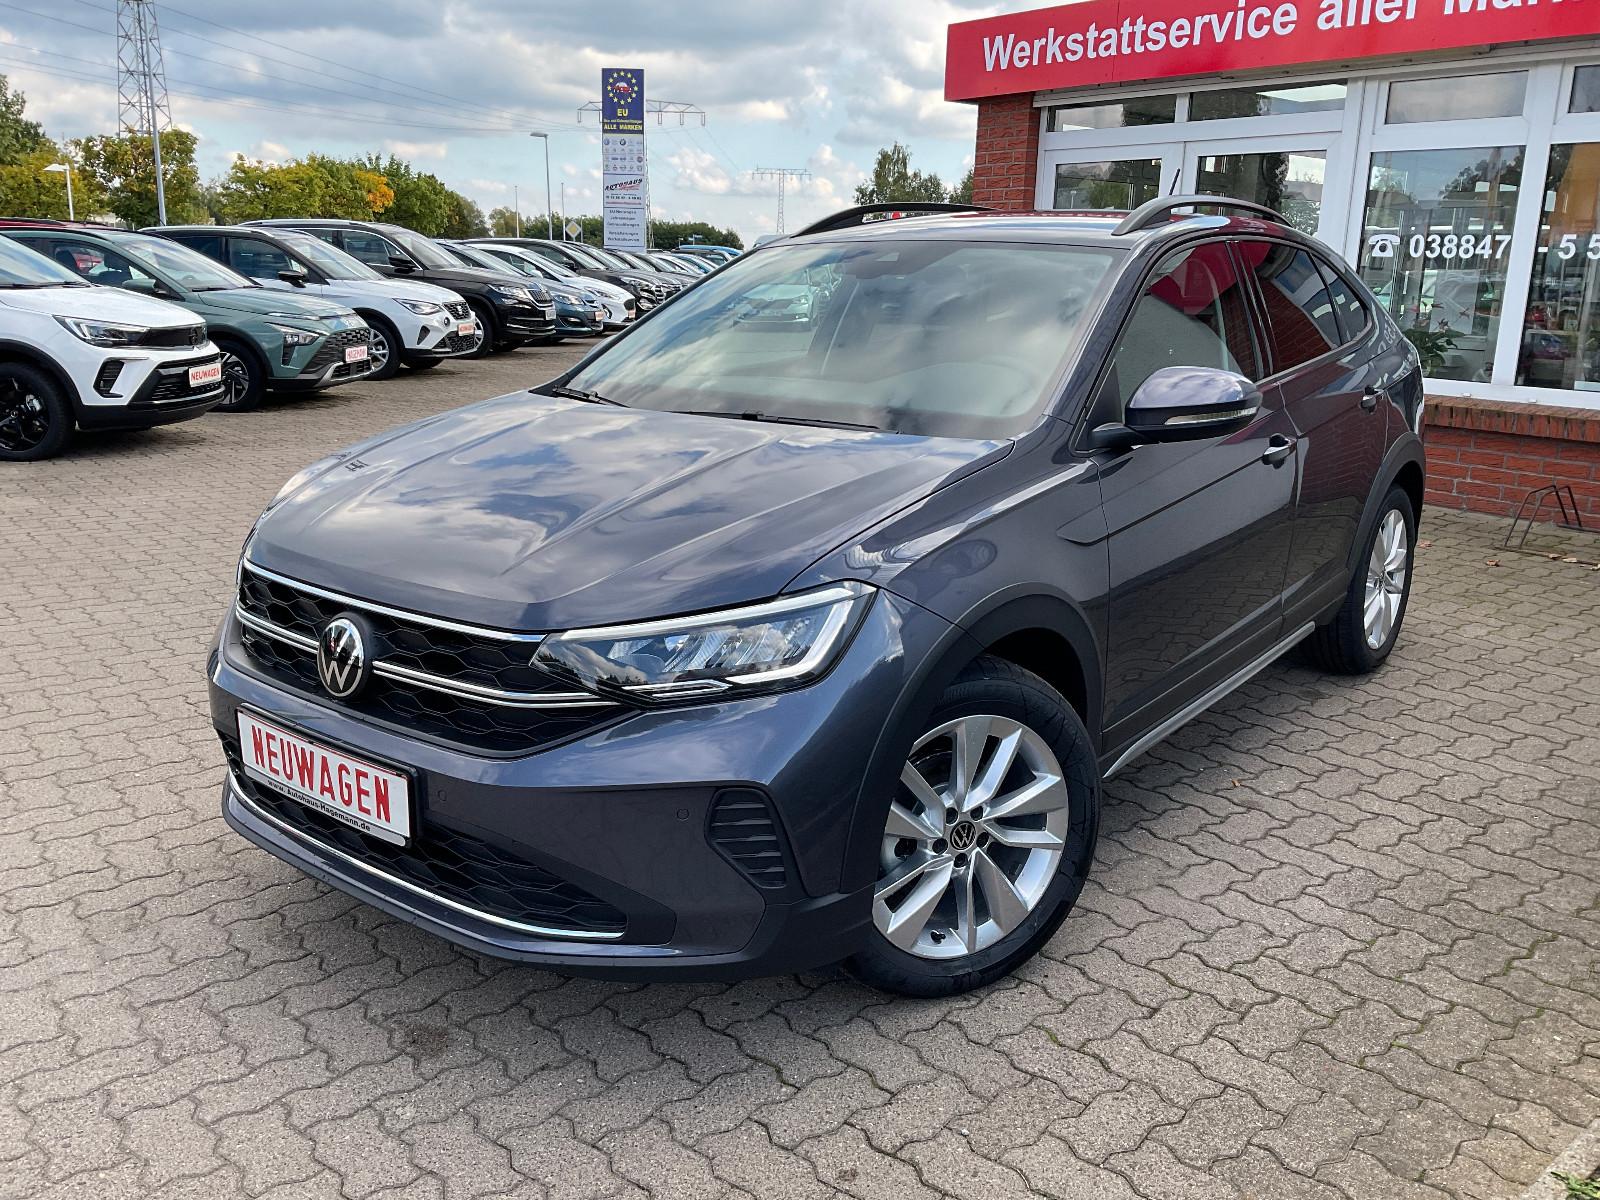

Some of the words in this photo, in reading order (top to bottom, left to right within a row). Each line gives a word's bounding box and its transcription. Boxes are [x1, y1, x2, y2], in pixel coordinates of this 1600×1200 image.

[982, 0, 1298, 72] Werkstattservice
[617, 108, 629, 117] EU
[1408, 233, 1512, 259] 038847
[251, 724, 391, 824] NEUWAGEN
